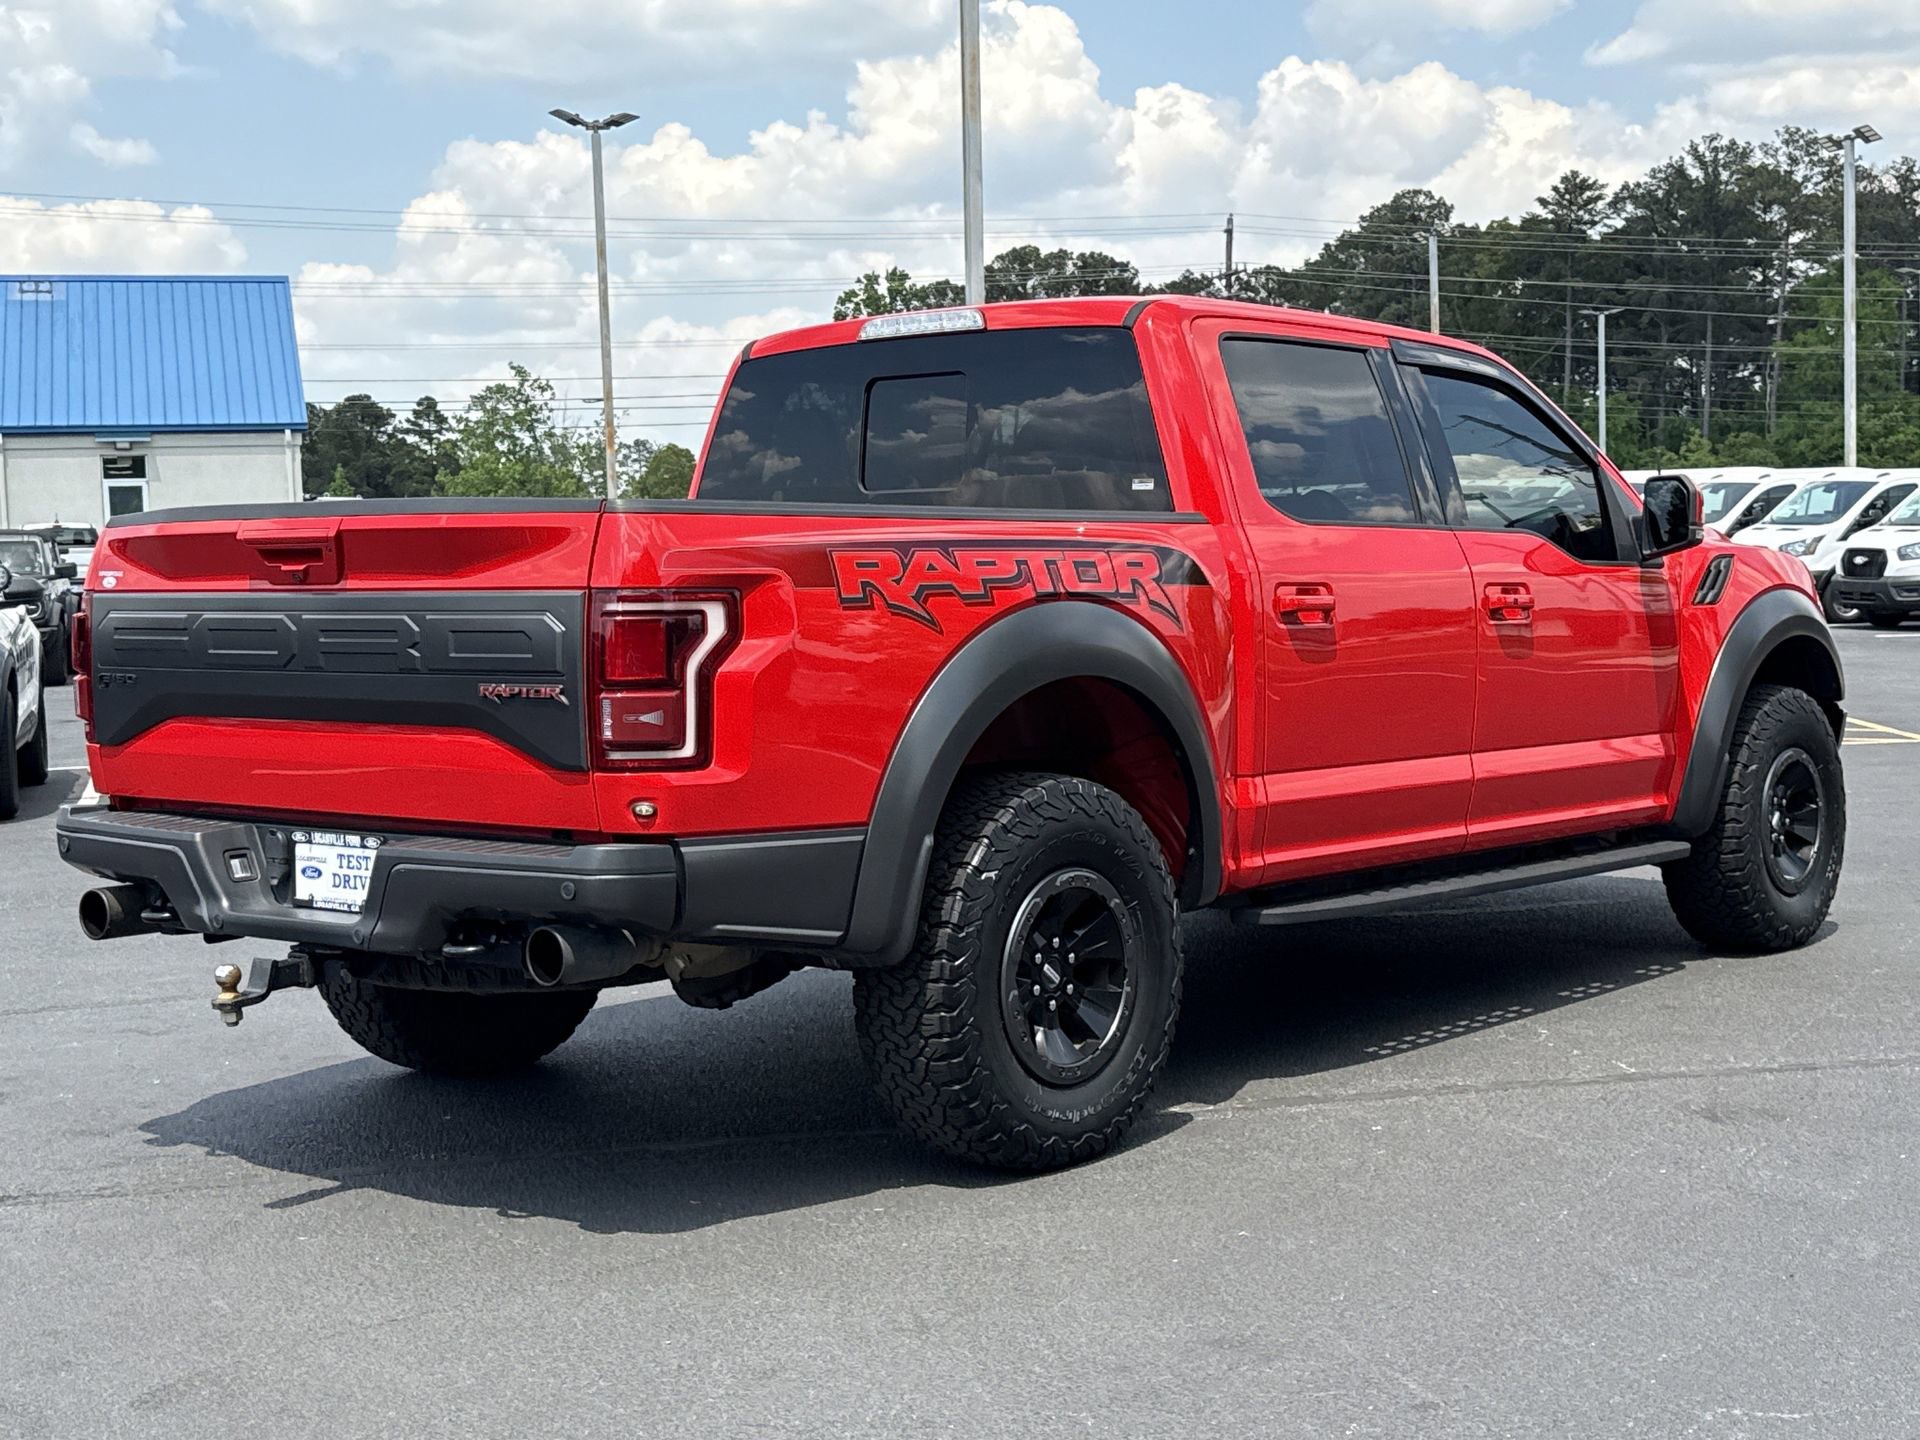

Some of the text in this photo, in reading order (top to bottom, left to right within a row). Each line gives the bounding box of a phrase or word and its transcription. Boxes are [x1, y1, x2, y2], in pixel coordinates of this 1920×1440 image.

[828, 548, 1184, 636] RAPTOR
[98, 611, 567, 677] FORD
[479, 683, 570, 706] RAPTOR
[337, 853, 371, 871] TEST
[303, 867, 321, 879] Ford
[332, 872, 369, 891] DRIV
